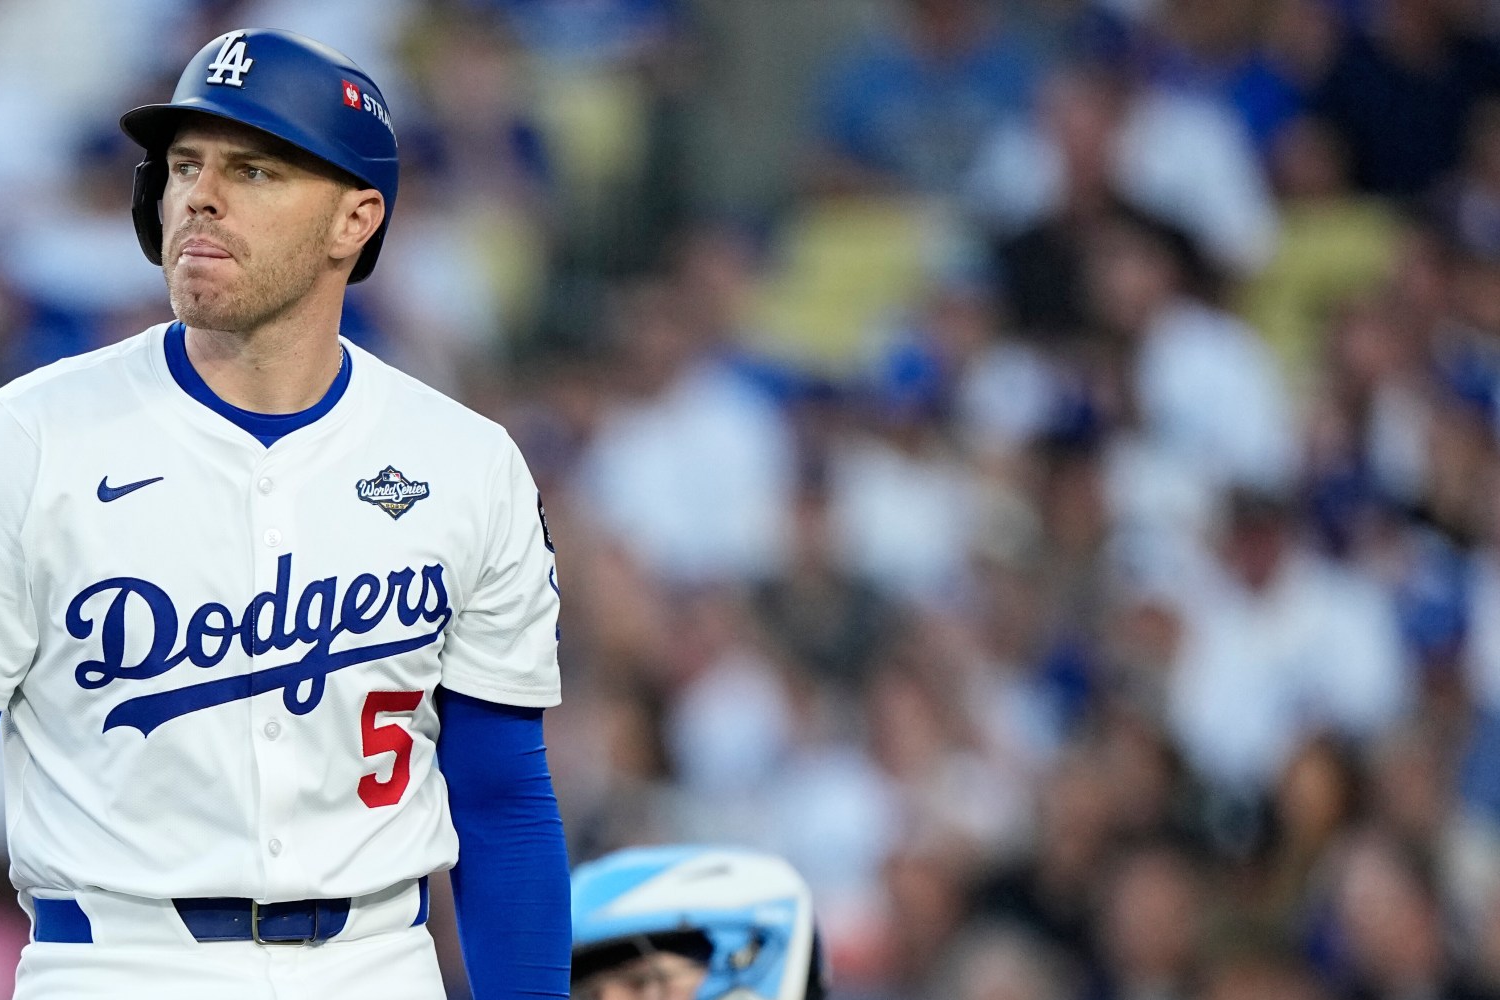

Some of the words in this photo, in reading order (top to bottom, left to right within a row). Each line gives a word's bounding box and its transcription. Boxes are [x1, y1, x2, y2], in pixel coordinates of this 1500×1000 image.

[206, 32, 254, 87] LA
[359, 480, 398, 497] World
[392, 481, 427, 503] Series
[65, 553, 452, 716] Dodgers
[357, 690, 425, 810] 5
